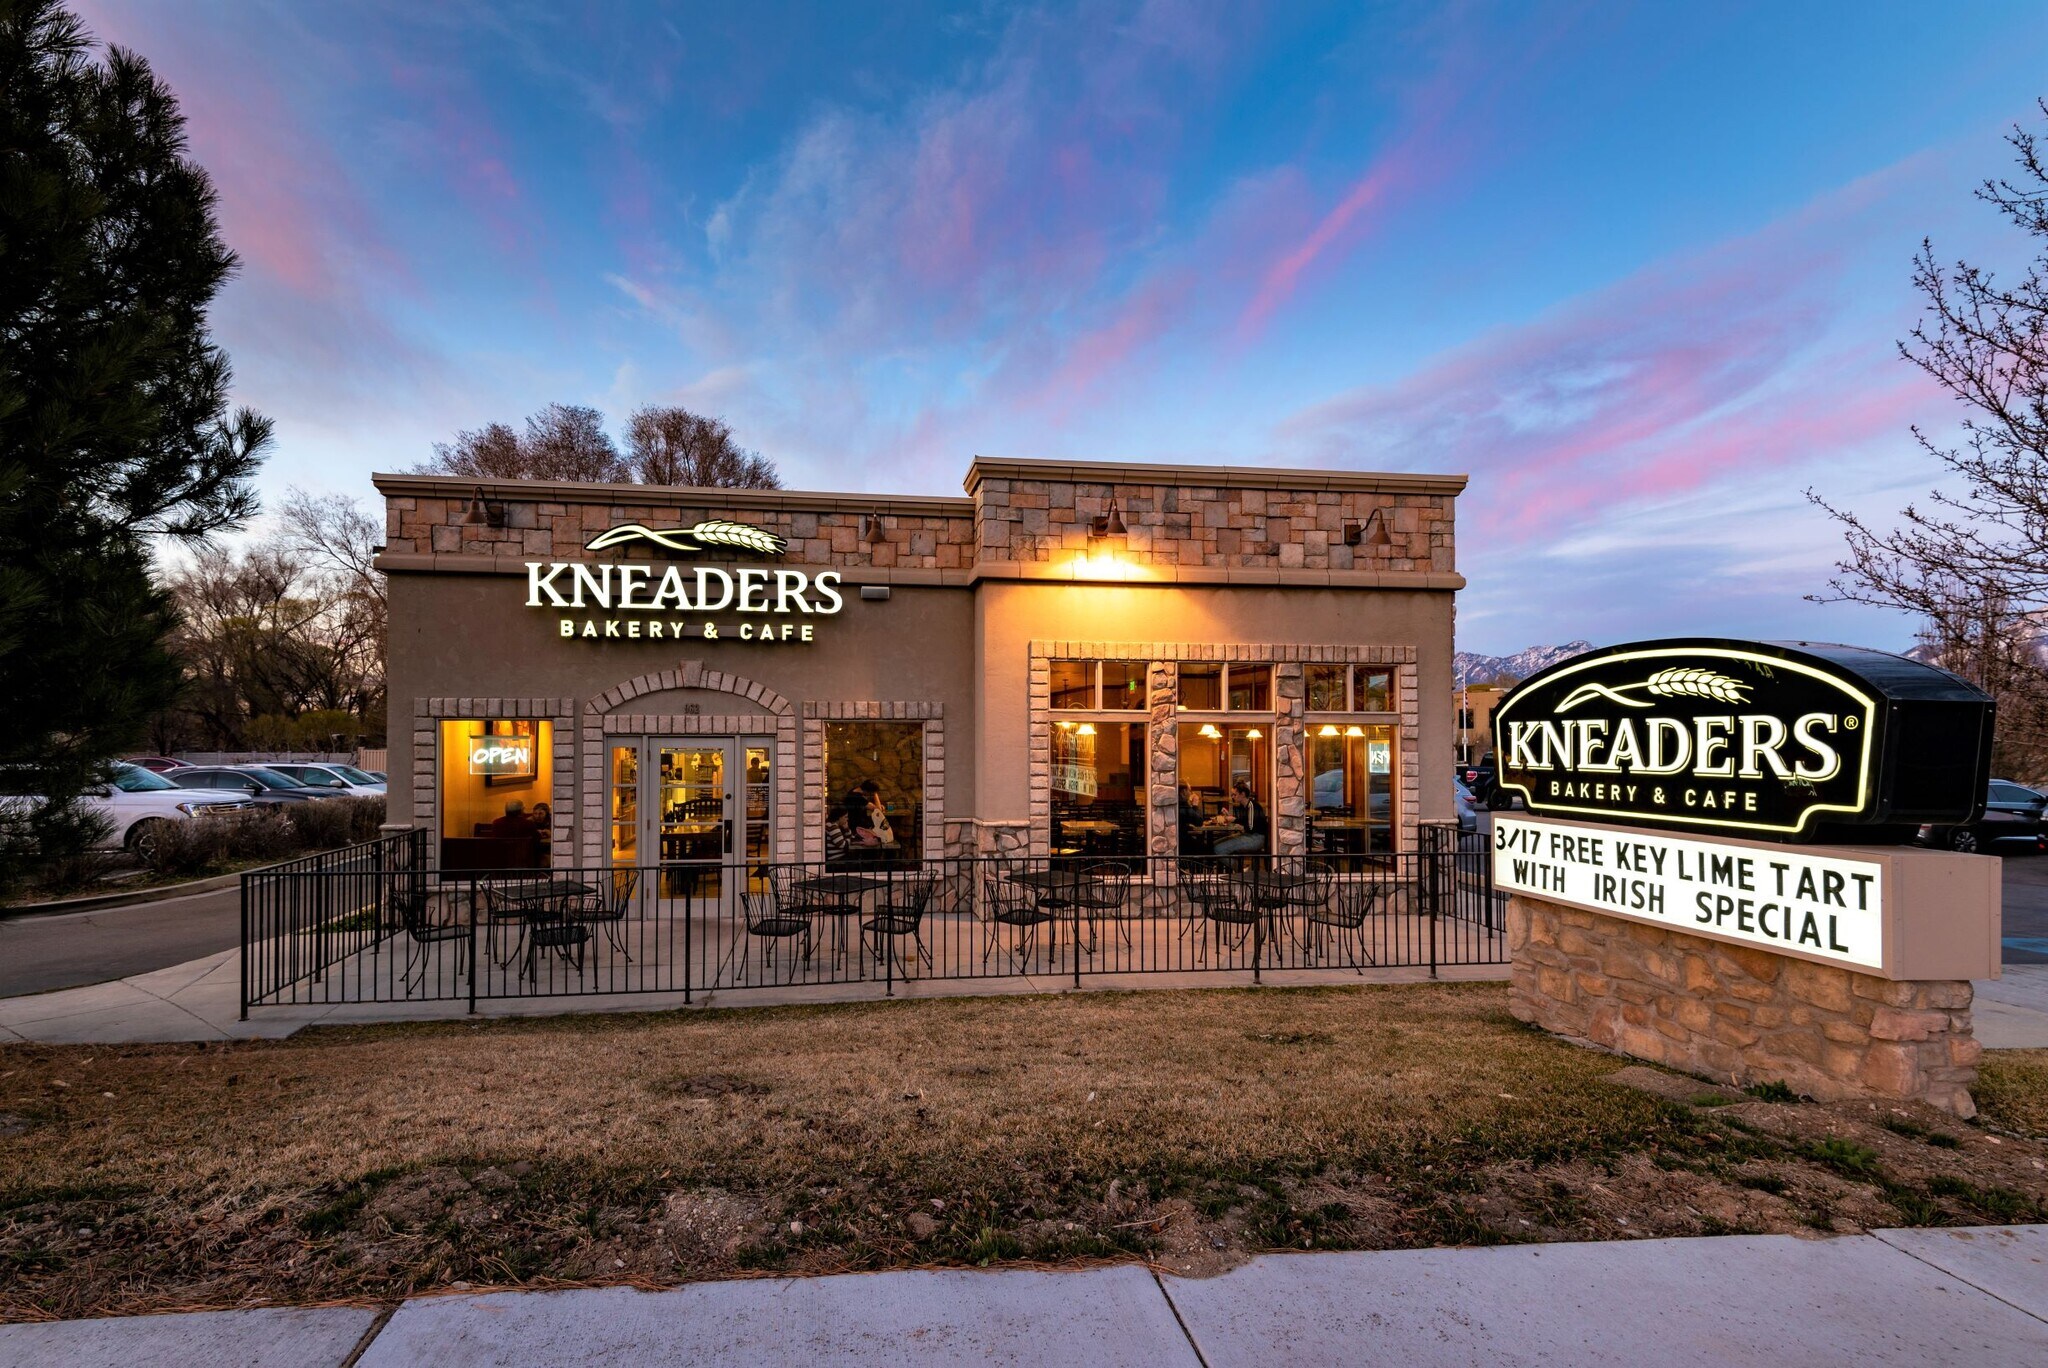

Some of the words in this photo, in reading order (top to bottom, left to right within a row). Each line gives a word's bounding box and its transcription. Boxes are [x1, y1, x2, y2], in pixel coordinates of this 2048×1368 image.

[525, 562, 843, 614] KNEADERS
[560, 619, 684, 639] BAKERY
[703, 622, 719, 639] &
[739, 623, 814, 642] CAFE
[473, 747, 528, 765] OPEN
[1550, 780, 1637, 802] BAKERY
[1654, 787, 1666, 805] &
[1684, 788, 1757, 812] CAFE
[1495, 826, 1541, 855] 3/17
[1551, 833, 1603, 866] FREE
[1617, 841, 1667, 876] KEY
[1678, 849, 1755, 892] LIME
[1770, 862, 1874, 911] TART
[1513, 858, 1565, 893] WITH
[1595, 873, 1664, 914] IRISH
[1697, 891, 1849, 953] SPECIAL
